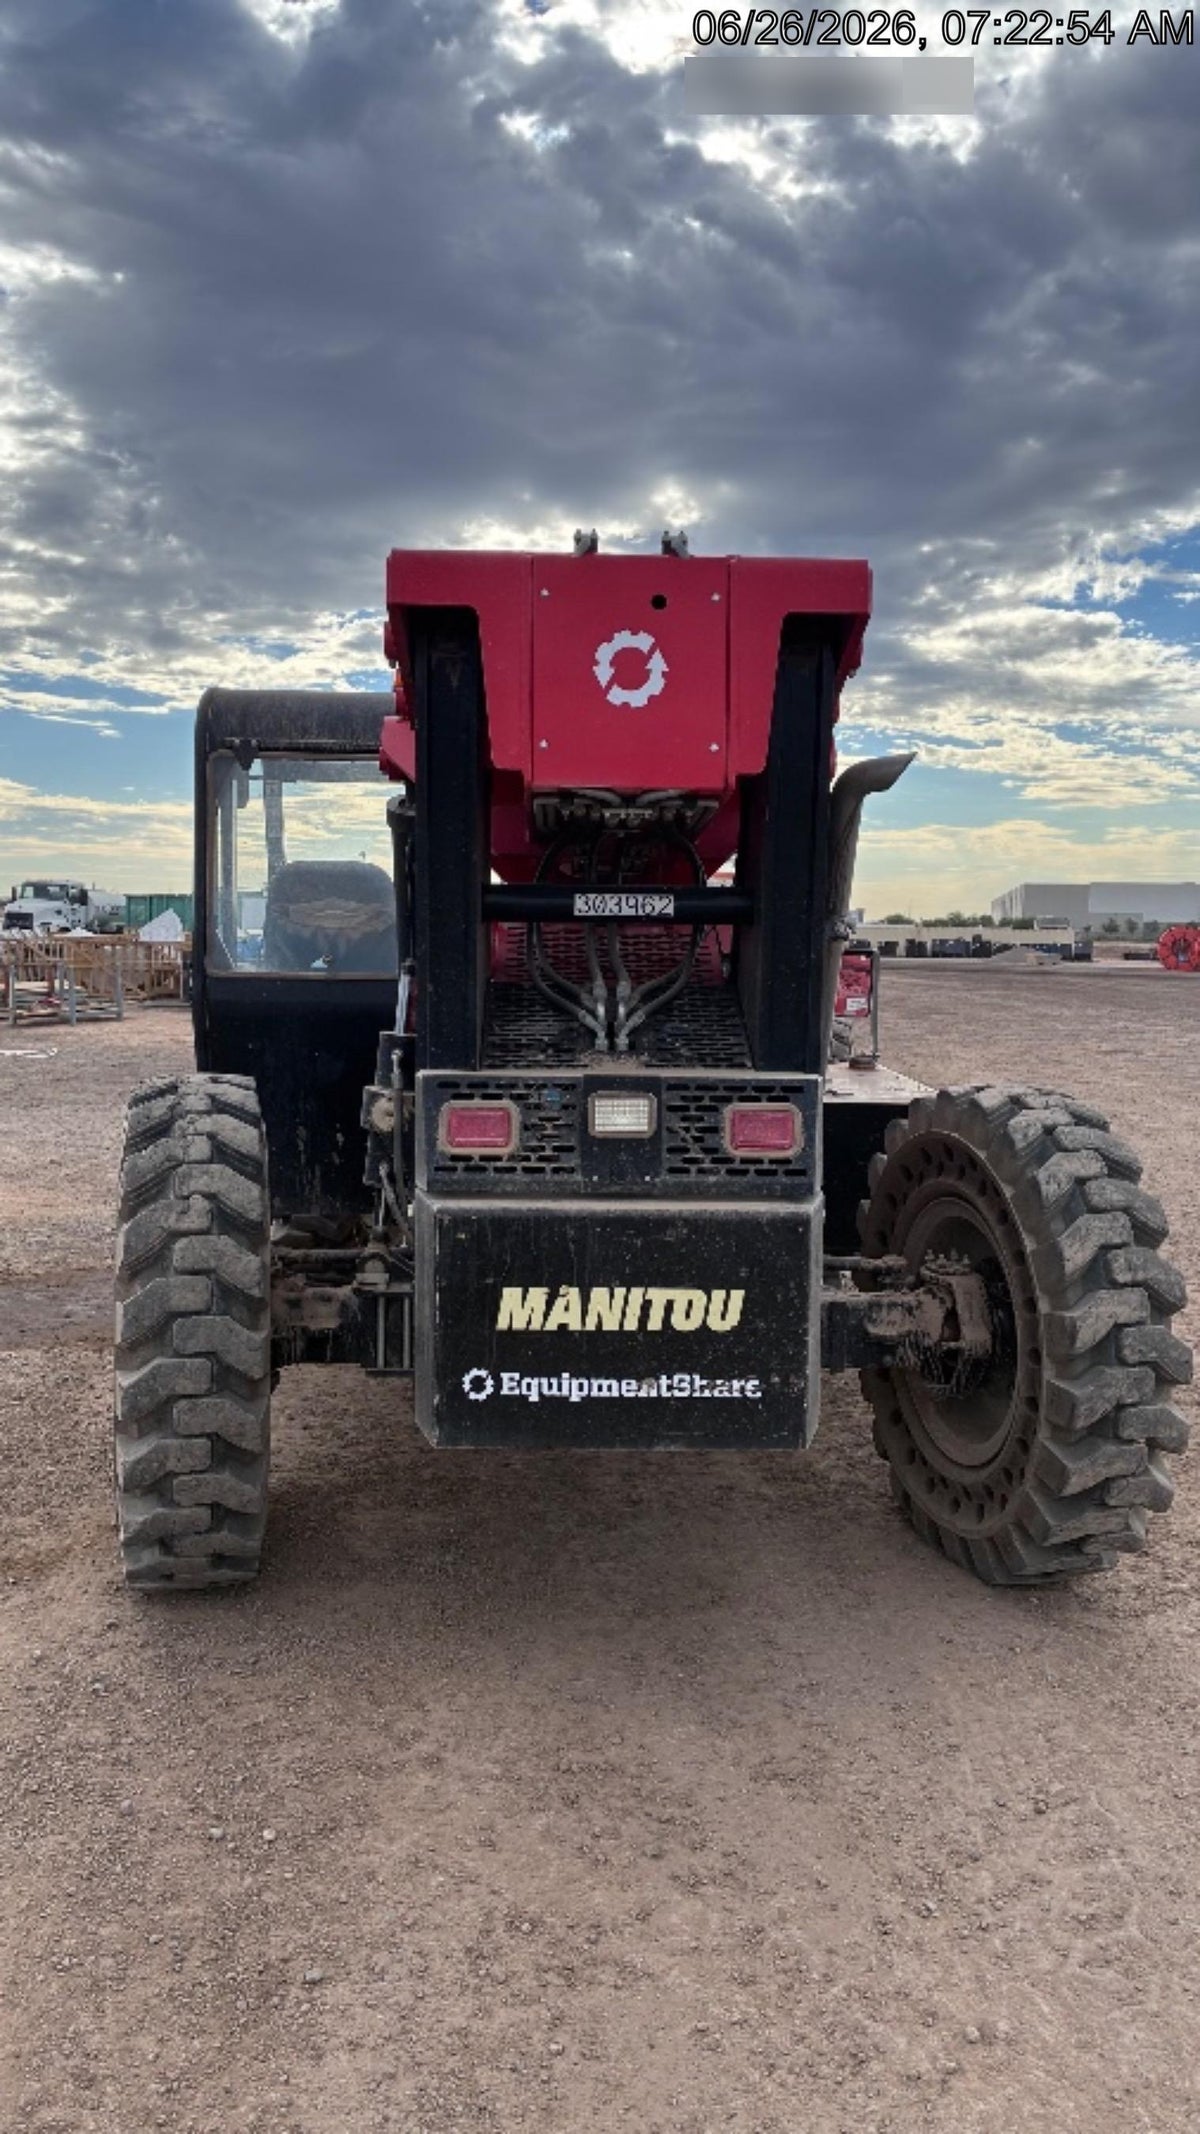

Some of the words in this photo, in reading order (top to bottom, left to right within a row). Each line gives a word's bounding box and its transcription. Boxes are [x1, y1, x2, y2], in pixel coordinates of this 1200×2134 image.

[576, 895, 673, 917] 303962
[496, 1285, 745, 1332] MANITOU
[499, 1371, 763, 1402] EquipmentShare
